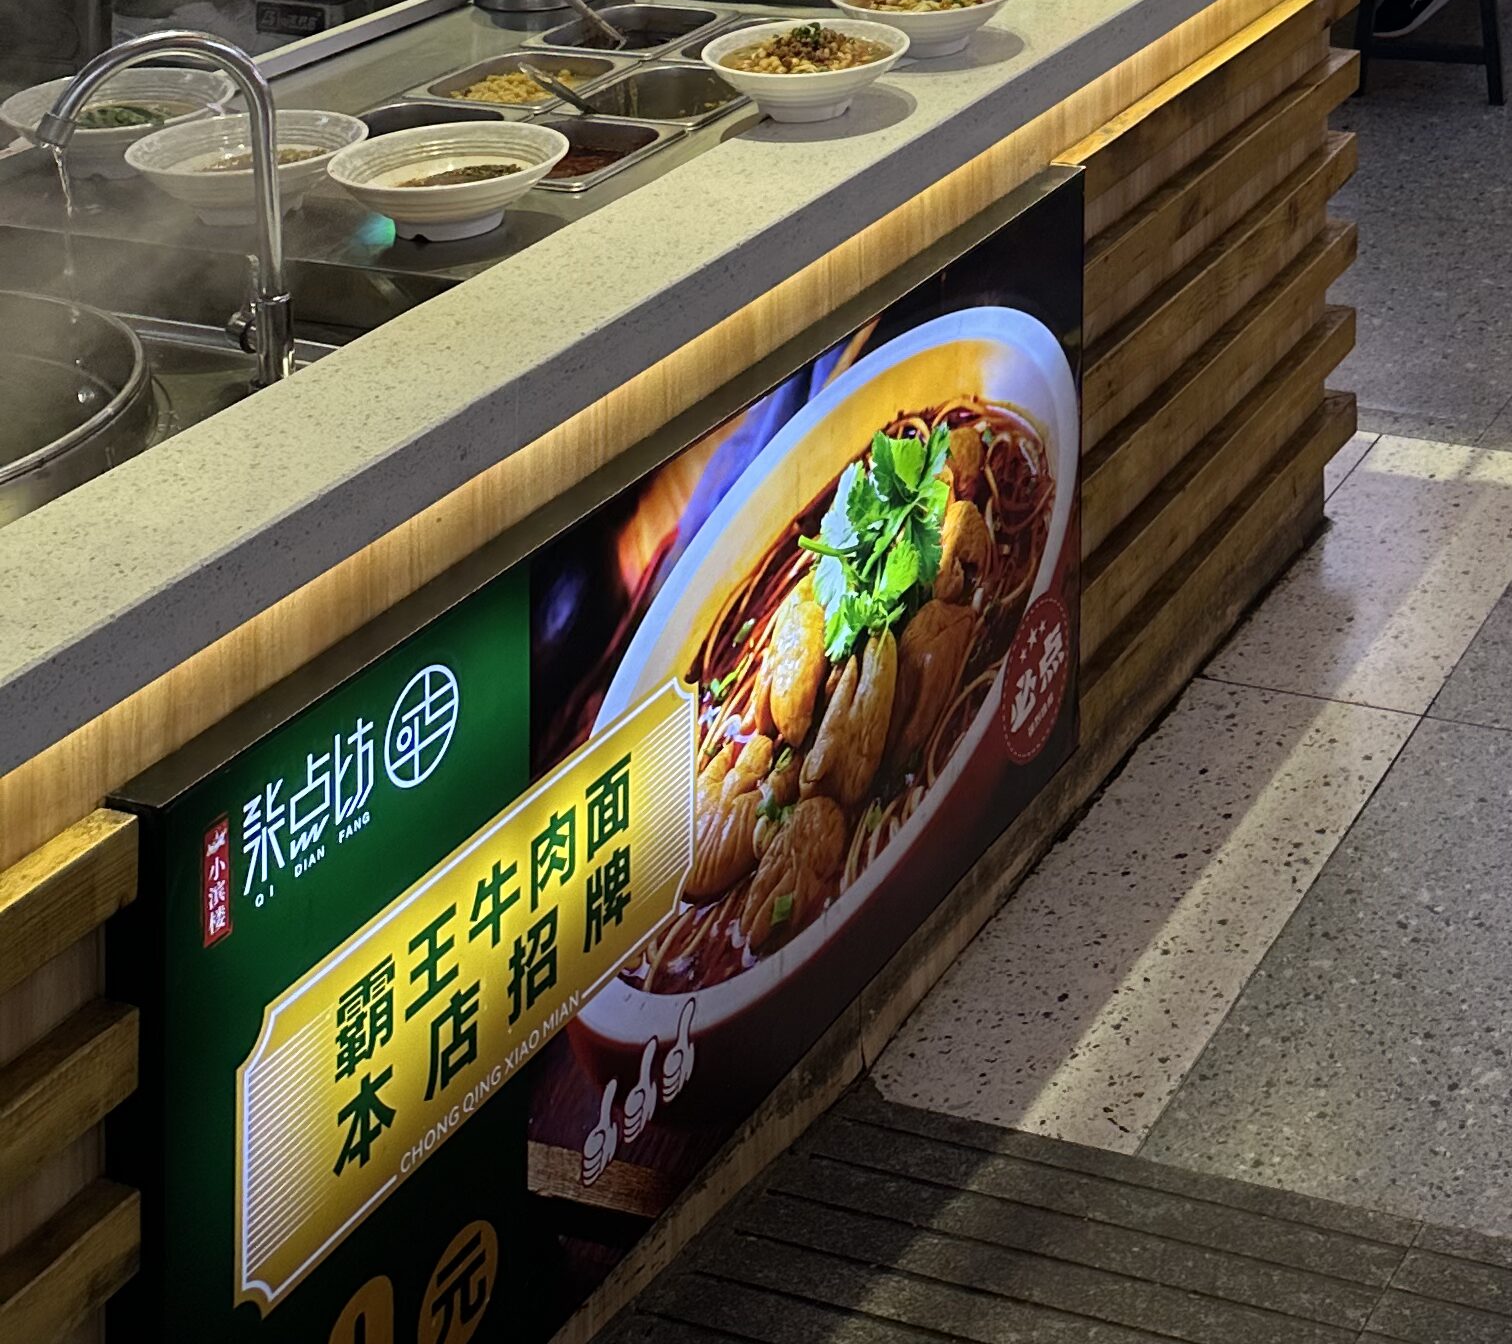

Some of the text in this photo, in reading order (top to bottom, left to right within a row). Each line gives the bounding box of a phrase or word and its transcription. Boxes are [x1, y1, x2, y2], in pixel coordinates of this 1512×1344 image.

[1011, 622, 1064, 733] 必点
[294, 845, 325, 878] DIAN
[338, 811, 371, 844] FANG
[335, 753, 633, 1084] 霸王牛肉面
[333, 852, 634, 1178] 本店招牌
[400, 990, 581, 1175] CHONG QING XIAO MIAN
